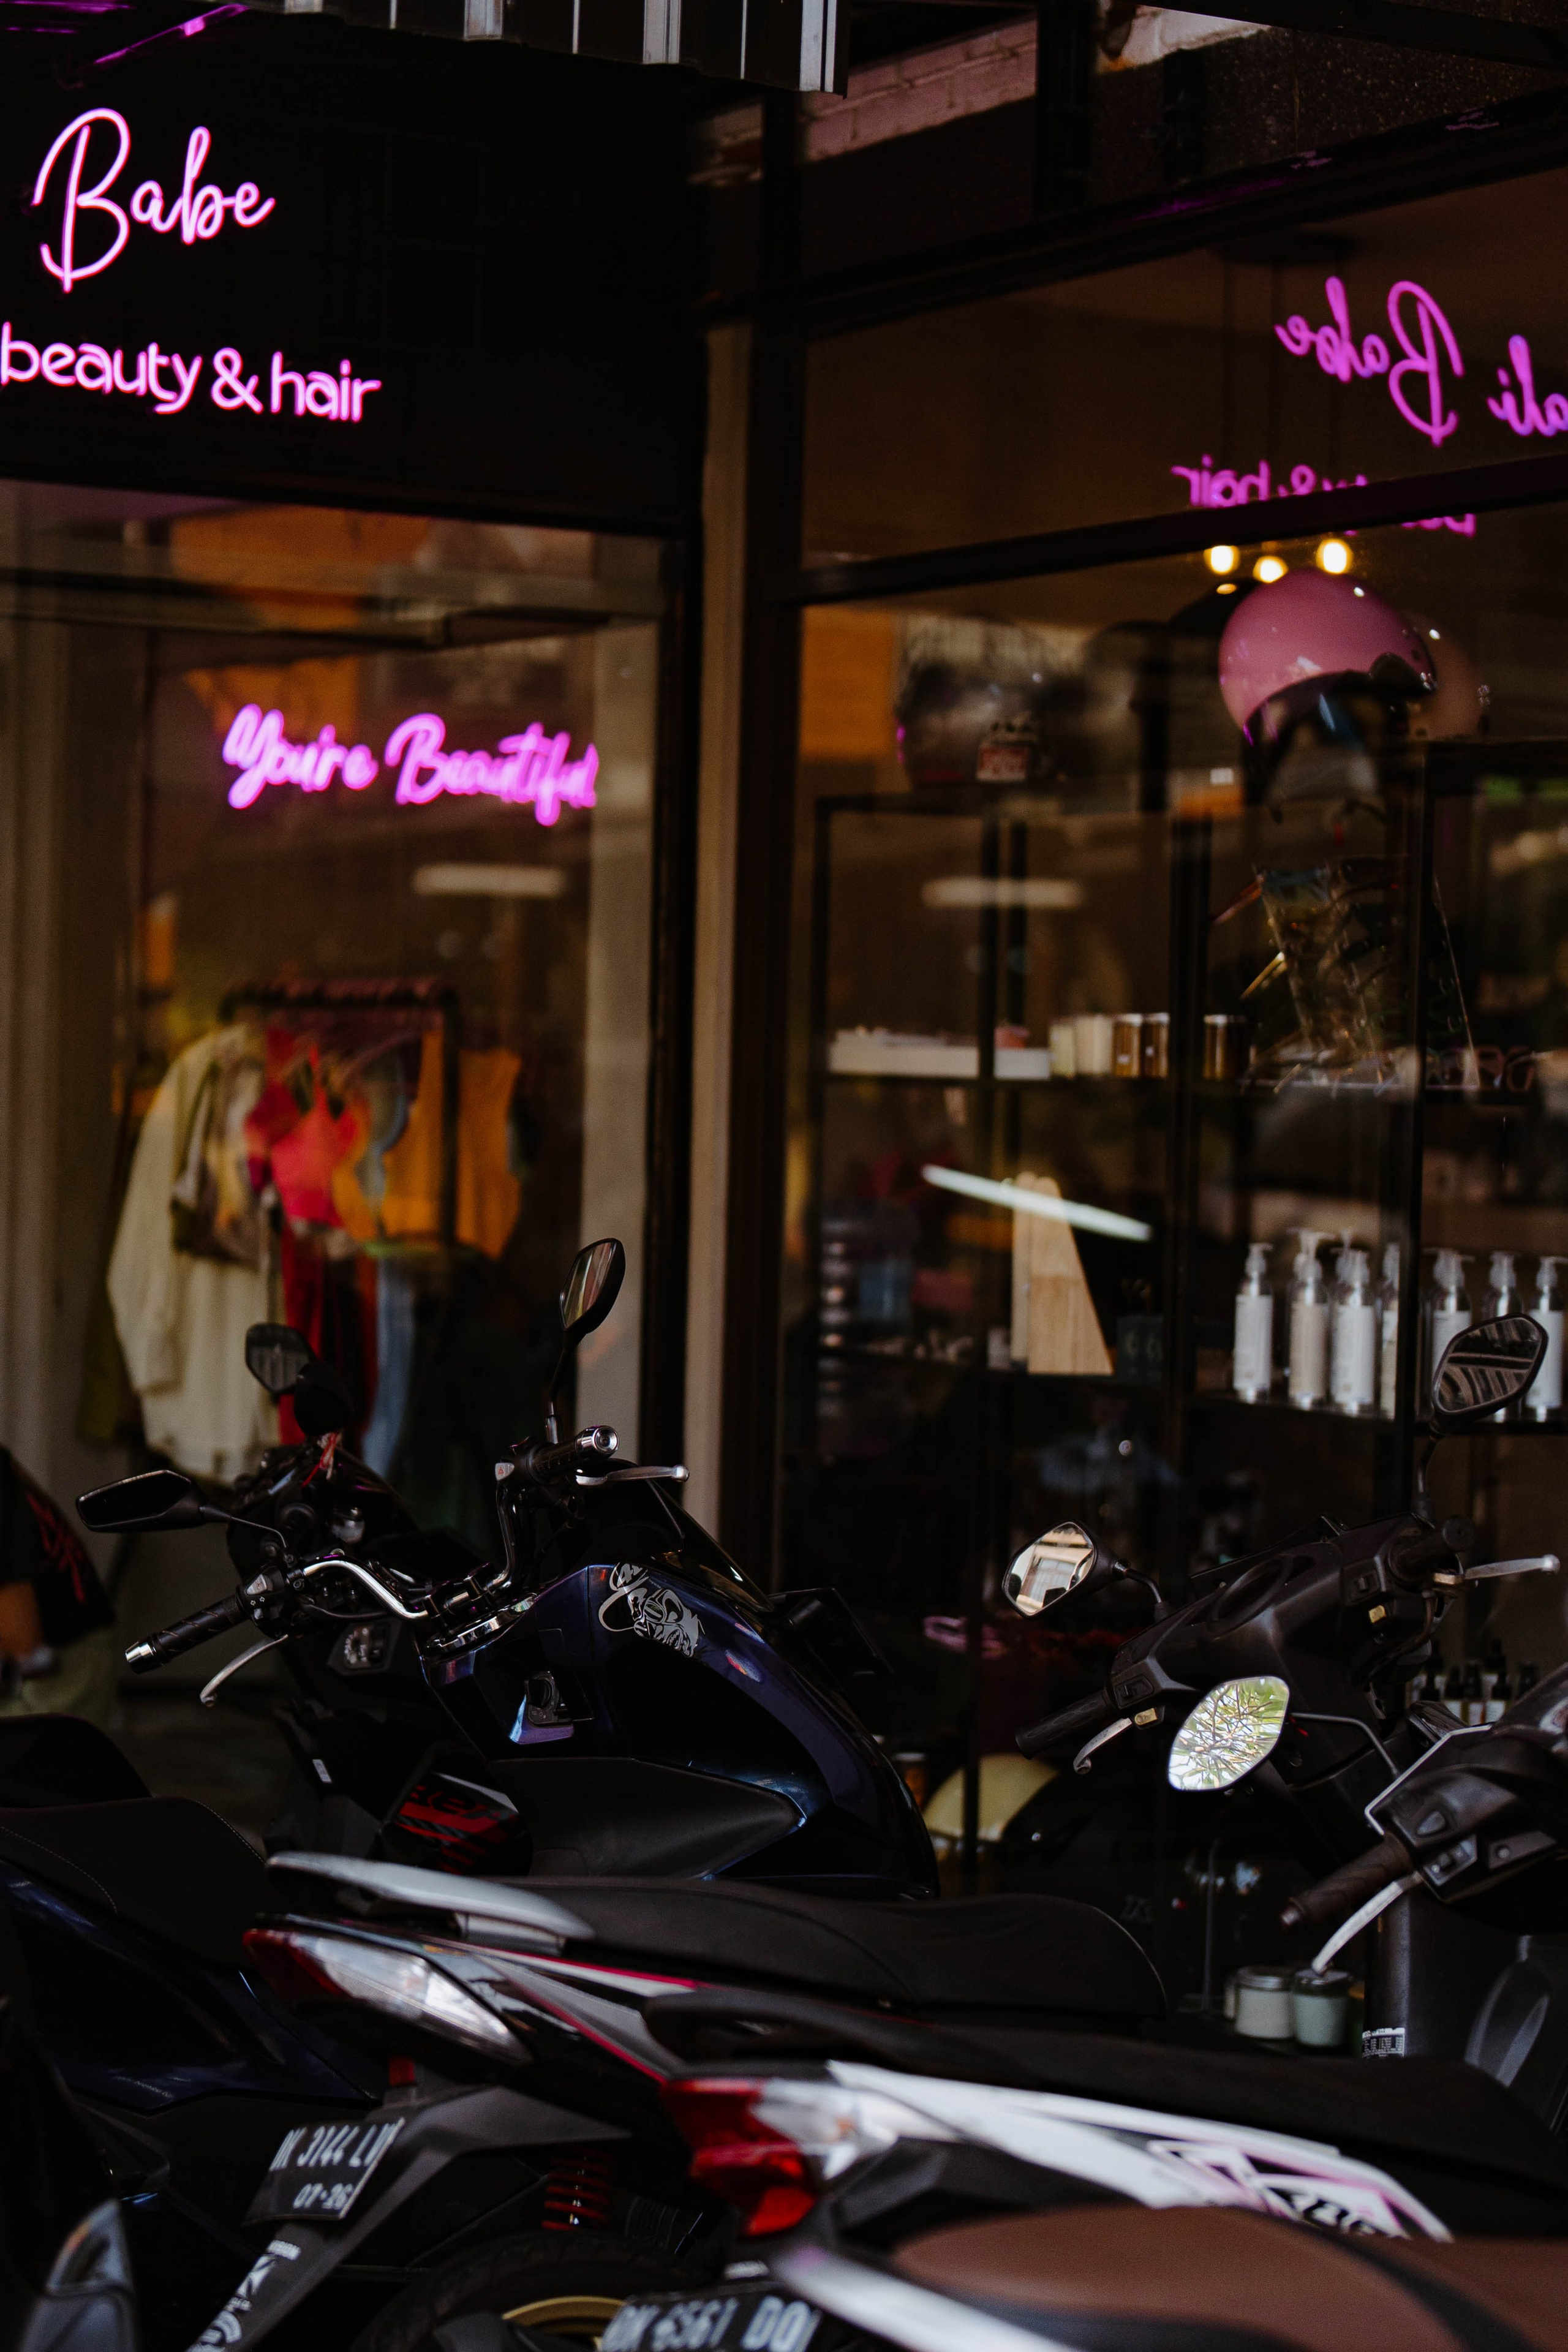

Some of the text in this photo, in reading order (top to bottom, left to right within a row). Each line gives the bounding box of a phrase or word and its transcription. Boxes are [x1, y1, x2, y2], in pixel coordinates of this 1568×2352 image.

[31, 107, 276, 293] Babe
[0, 322, 382, 422] beauty & hair
